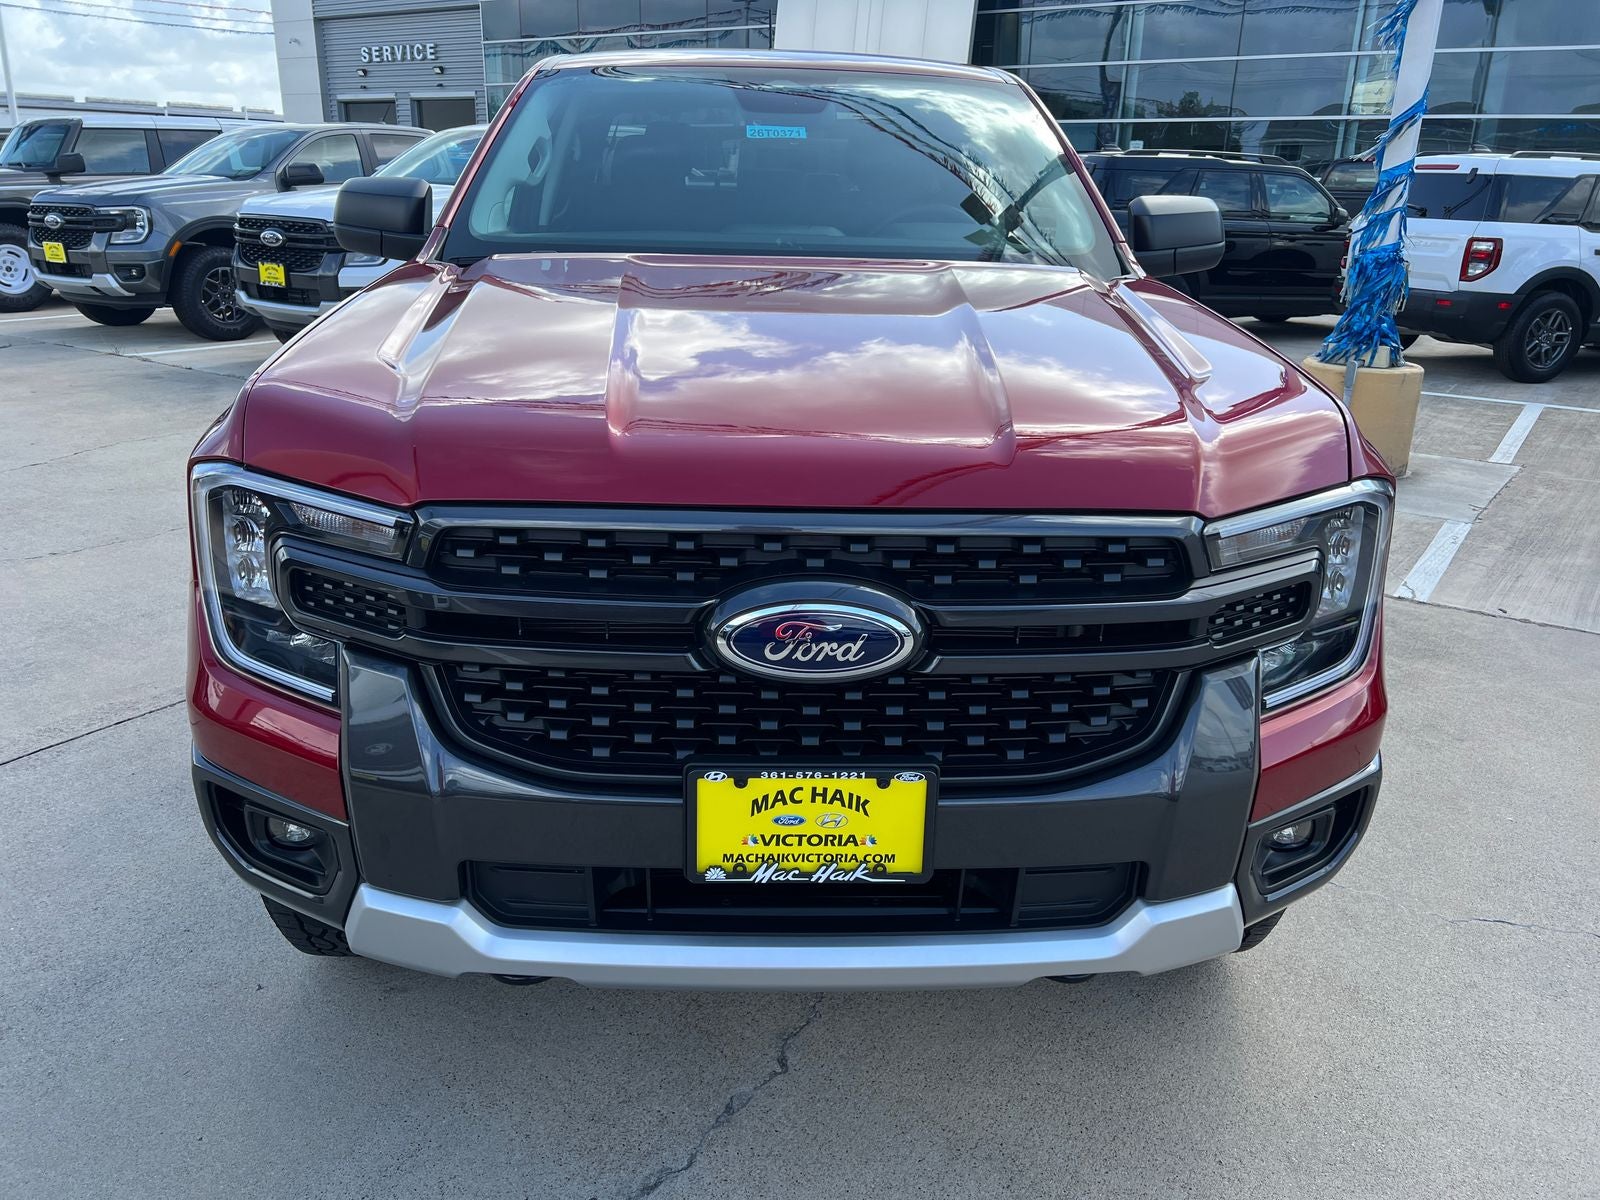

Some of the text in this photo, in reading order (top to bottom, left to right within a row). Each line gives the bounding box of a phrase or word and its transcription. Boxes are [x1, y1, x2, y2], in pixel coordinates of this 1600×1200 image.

[360, 43, 436, 62] SERVICE
[749, 127, 801, 137] 26T0371
[764, 621, 868, 662] Ford
[760, 771, 867, 779] 361-576-1221
[899, 773, 920, 782] Ford
[750, 786, 871, 818] MAC HAIK
[777, 815, 801, 826] Ford
[759, 834, 860, 847] VICTORIA
[721, 853, 896, 864] MACHAIKVICTORIA.COM
[750, 862, 872, 883] Mac Haik
